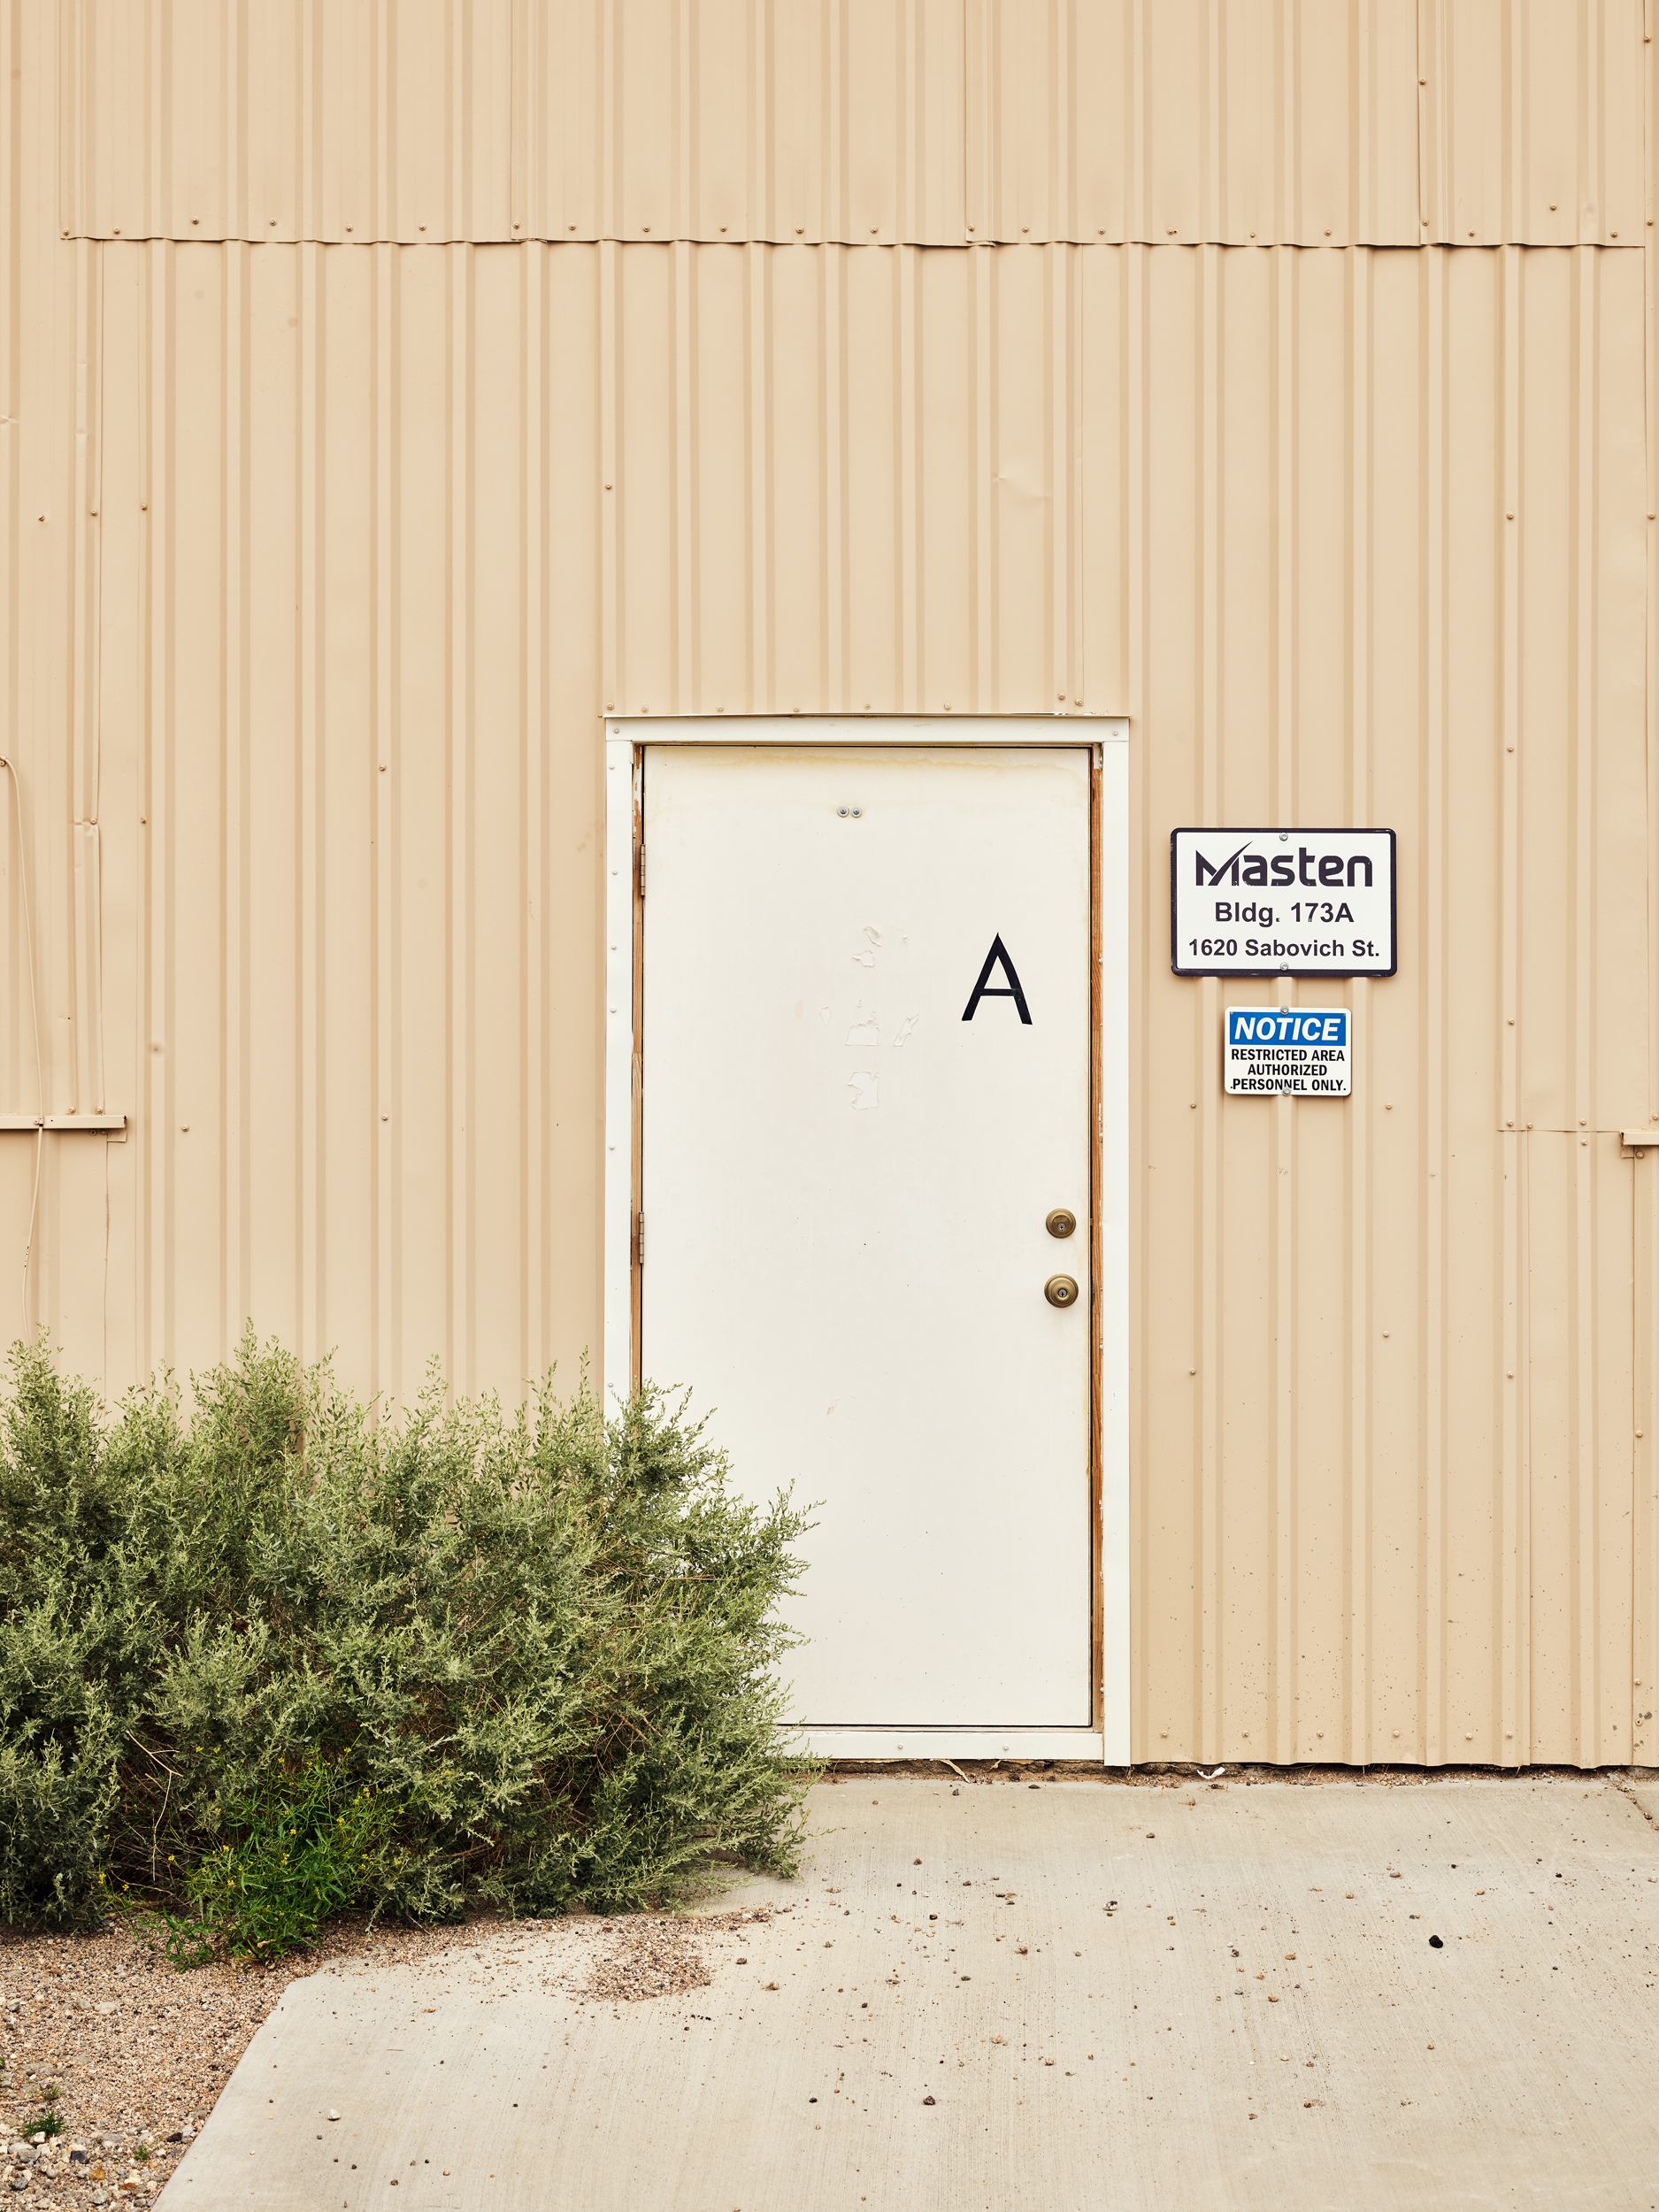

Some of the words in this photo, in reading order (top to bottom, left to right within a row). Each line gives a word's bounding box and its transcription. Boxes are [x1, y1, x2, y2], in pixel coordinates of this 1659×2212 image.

[1195, 841, 1373, 887] Masten
[1215, 902, 1280, 928] Bldg.
[1290, 902, 1355, 923] 173A
[1188, 939, 1238, 956] 1620
[1245, 939, 1344, 956] Sabovich
[1352, 940, 1380, 957] St.
[961, 932, 1033, 1025] A
[1234, 1017, 1341, 1041] NOTICE
[1231, 1048, 1308, 1061] RESTRICTED
[1311, 1049, 1345, 1062] AREA
[1248, 1064, 1328, 1076] AUTHORIZED
[1233, 1078, 1308, 1091] PERSONNEL
[1311, 1079, 1347, 1091] ONLY.
